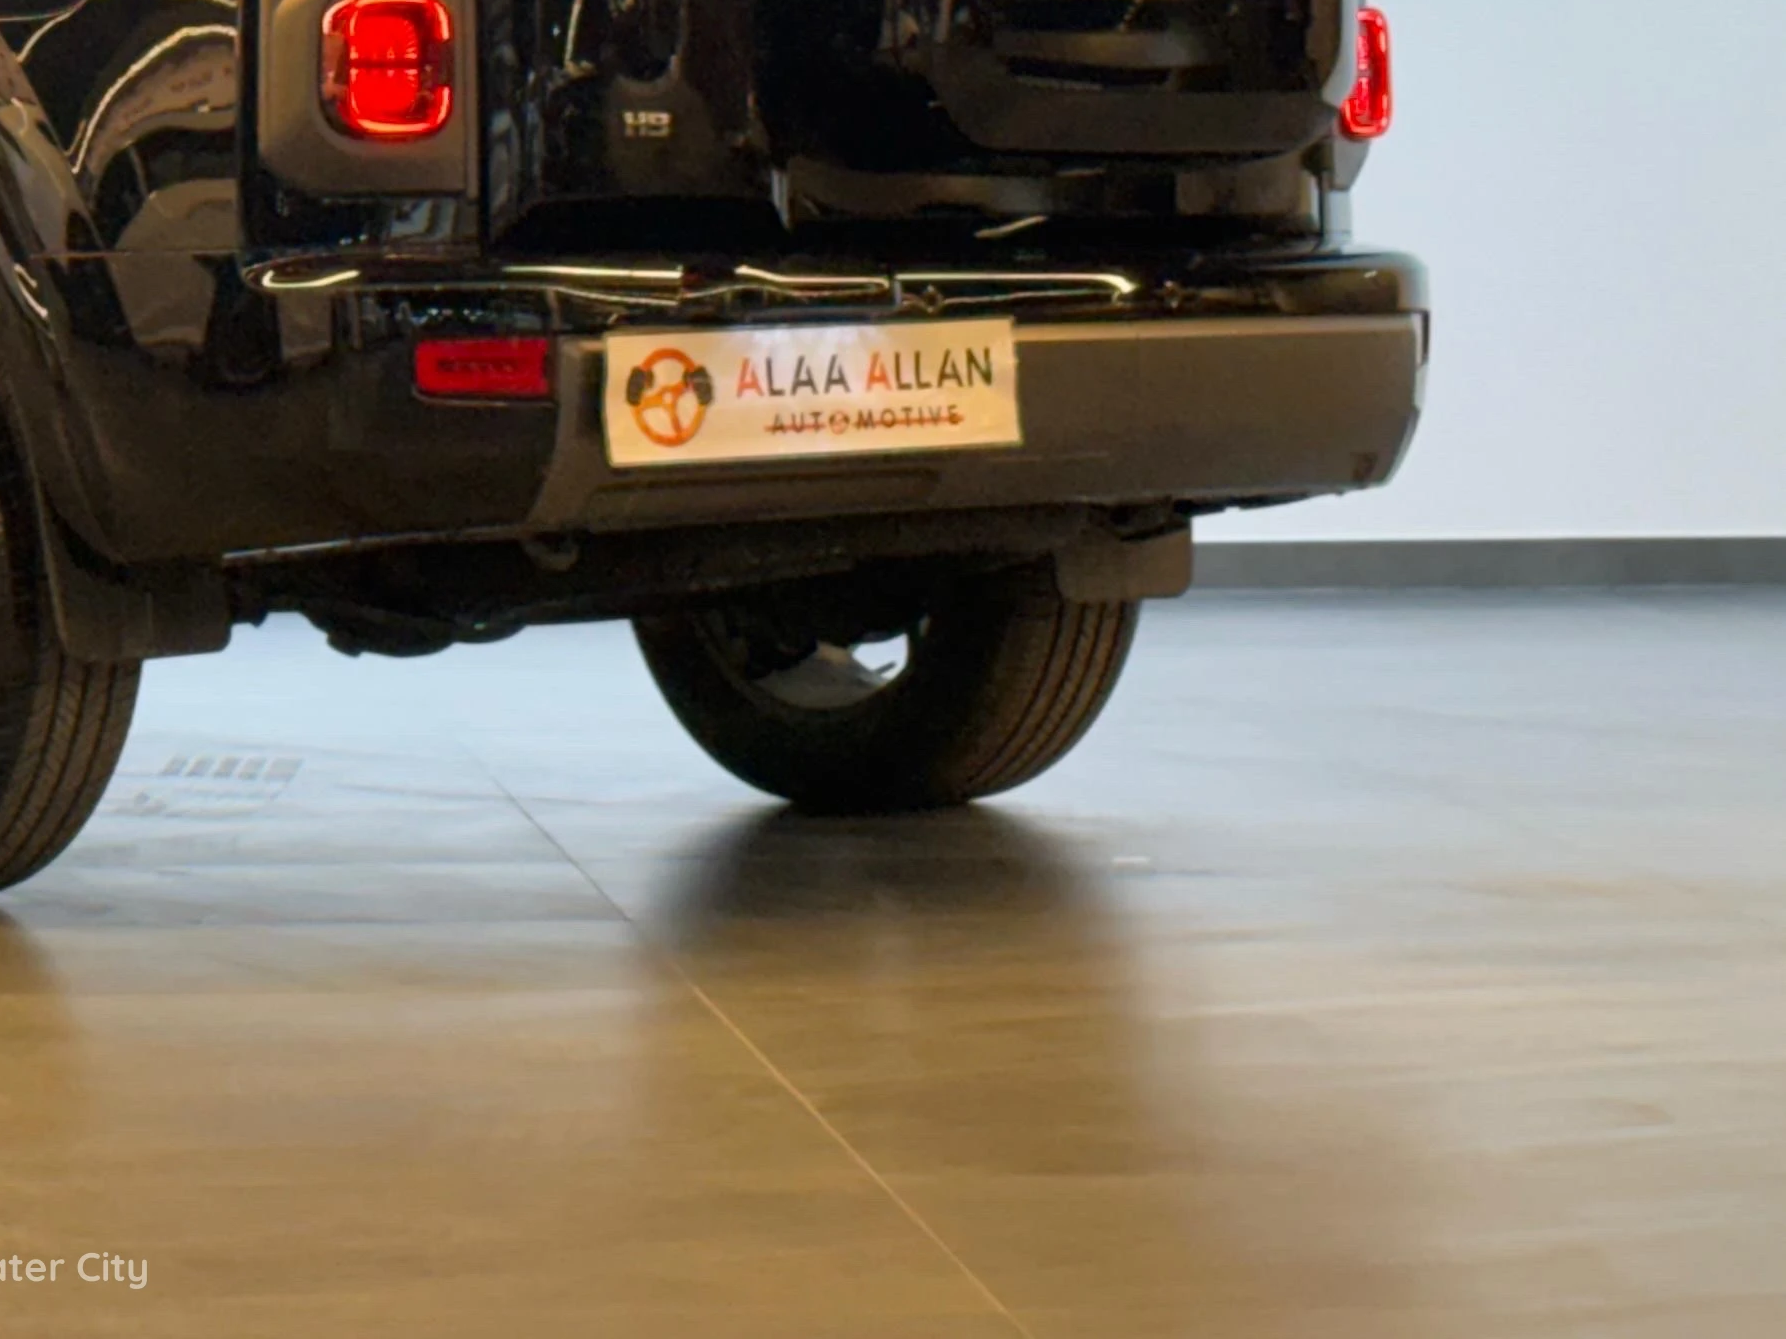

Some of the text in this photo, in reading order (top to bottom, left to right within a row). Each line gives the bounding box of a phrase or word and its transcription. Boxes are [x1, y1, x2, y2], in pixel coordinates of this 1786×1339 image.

[736, 346, 994, 398] ALAA ALLAN
[769, 403, 962, 435] AUTOMOTIVE
